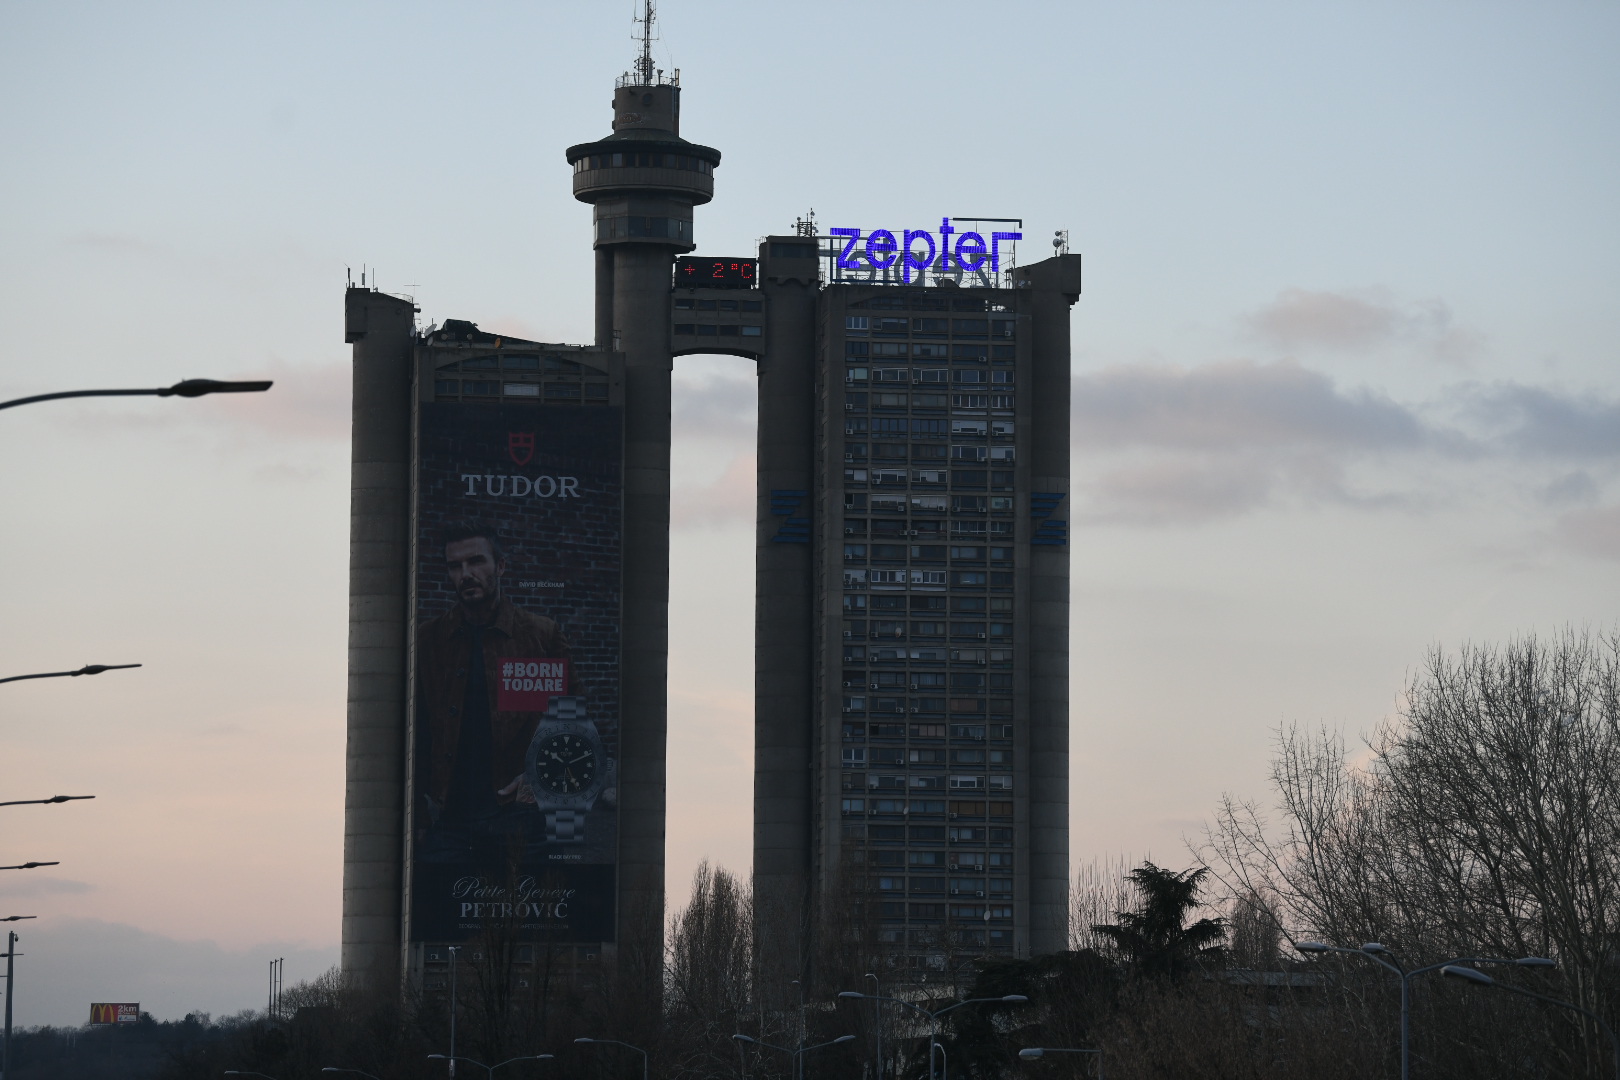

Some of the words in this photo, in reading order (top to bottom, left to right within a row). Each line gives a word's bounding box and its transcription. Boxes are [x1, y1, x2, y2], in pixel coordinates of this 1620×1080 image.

[830, 217, 1022, 283] zepter
[460, 473, 581, 498] TUDOR
[502, 662, 564, 678] #BORN
[502, 678, 563, 691] TODARE
[452, 876, 506, 899] Petite
[459, 898, 568, 919] PETROVIĆ
